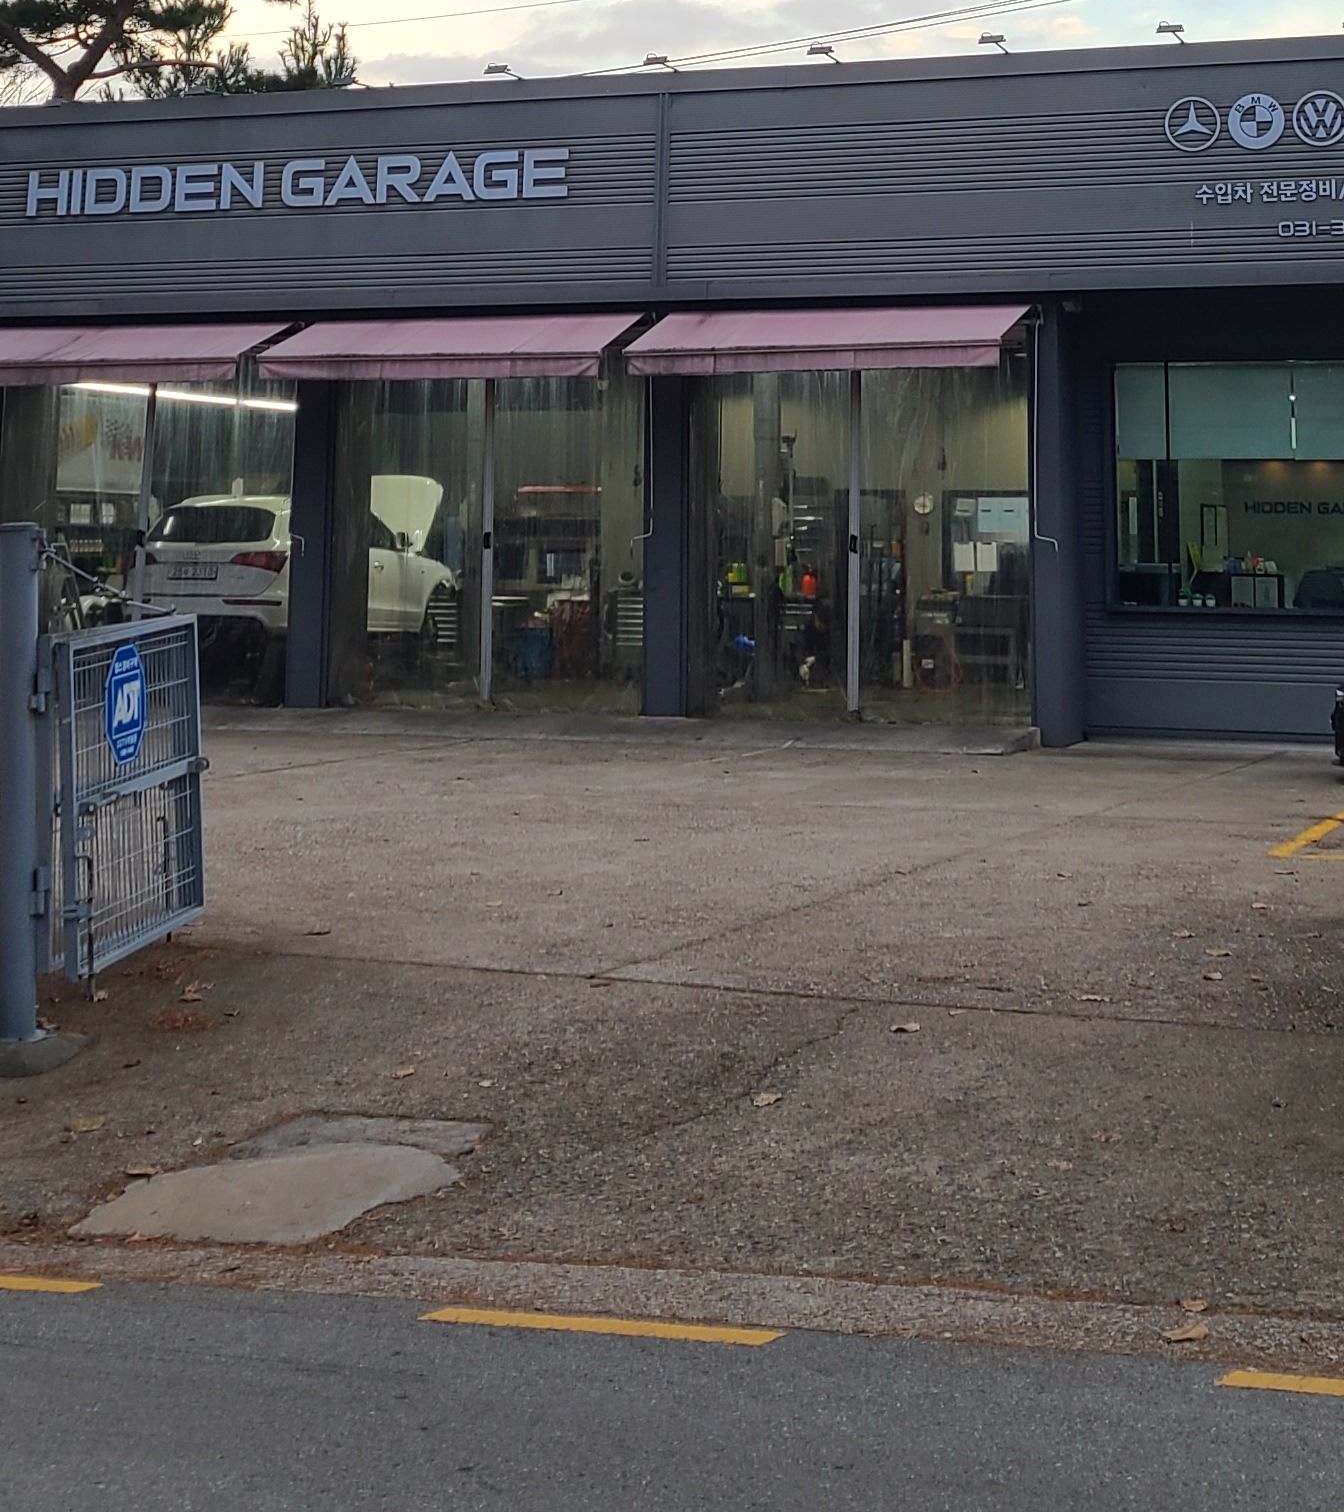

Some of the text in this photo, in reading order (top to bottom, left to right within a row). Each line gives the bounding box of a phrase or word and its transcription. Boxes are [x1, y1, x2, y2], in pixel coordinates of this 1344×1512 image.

[1235, 96, 1278, 113] BMW
[26, 147, 570, 217] HIDDEN GARAGE
[1195, 183, 1253, 205] 수입차
[1244, 501, 1312, 514] HIDDEN
[113, 679, 141, 729] ADT
